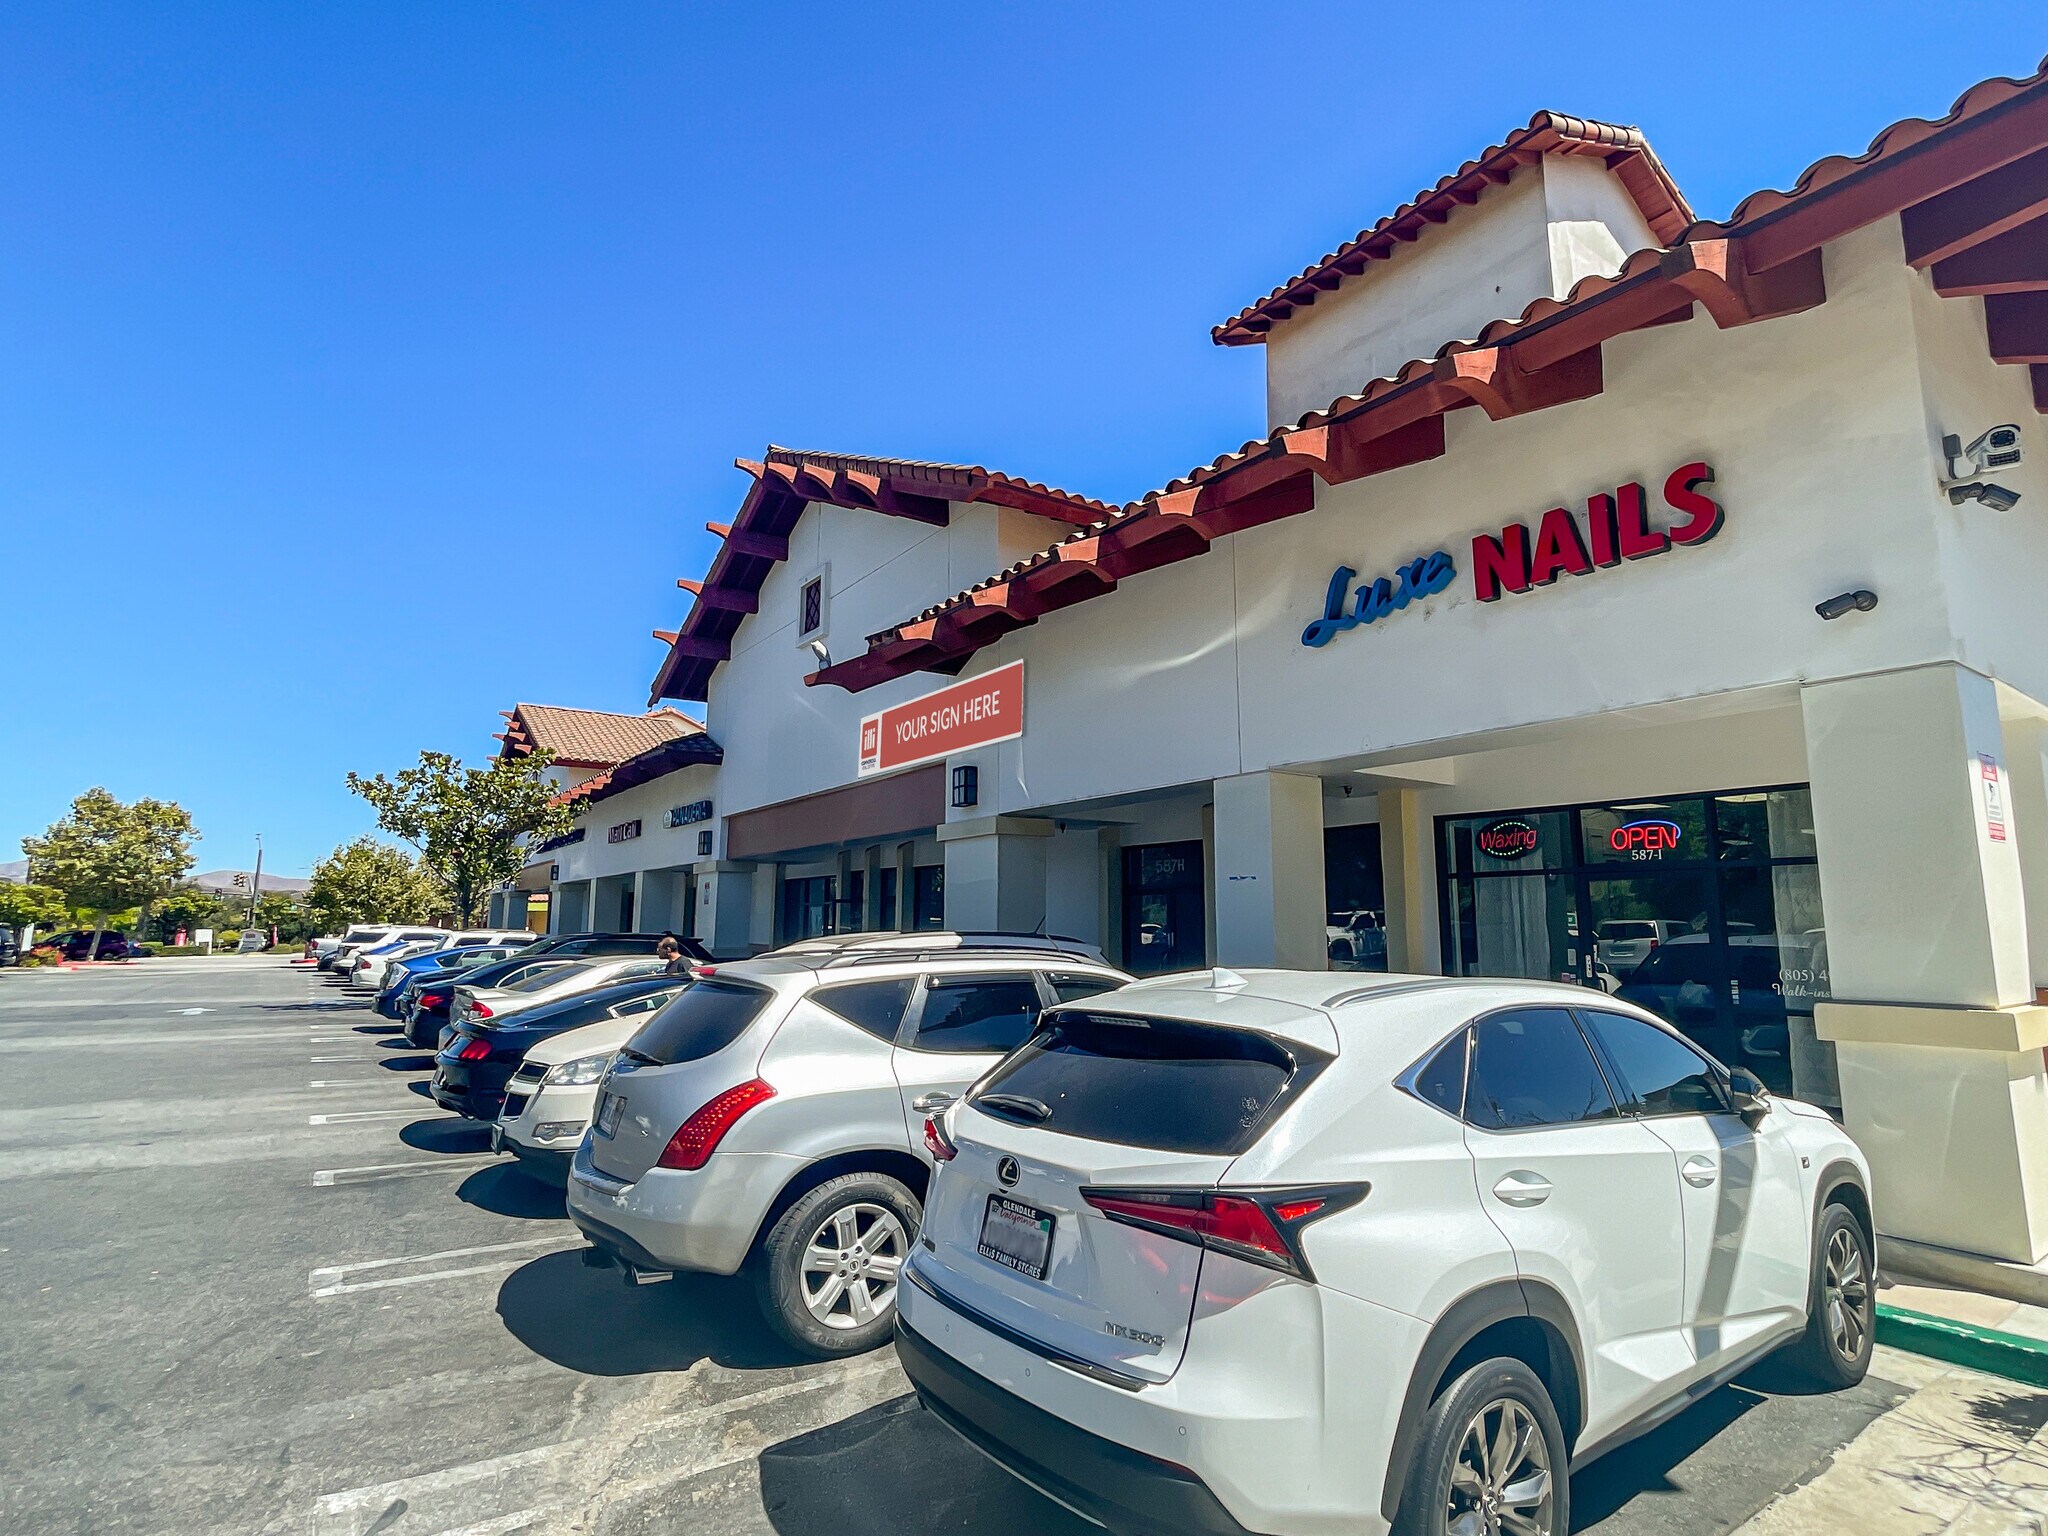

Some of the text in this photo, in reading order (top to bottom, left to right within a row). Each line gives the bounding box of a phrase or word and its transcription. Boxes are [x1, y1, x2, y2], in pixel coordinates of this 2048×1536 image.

[1301, 462, 1724, 648] Luxe NAILS
[896, 690, 1000, 744] YOUR SIGN HERE
[1481, 828, 1537, 849] Waxing
[1610, 827, 1677, 850] OPEN
[1155, 858, 1185, 874] 587H
[1779, 969, 1830, 983] (805) 4
[1772, 983, 1831, 998] Walk-ins
[1002, 1200, 1037, 1218] GLENDALE
[995, 1251, 1018, 1268] FAMILY
